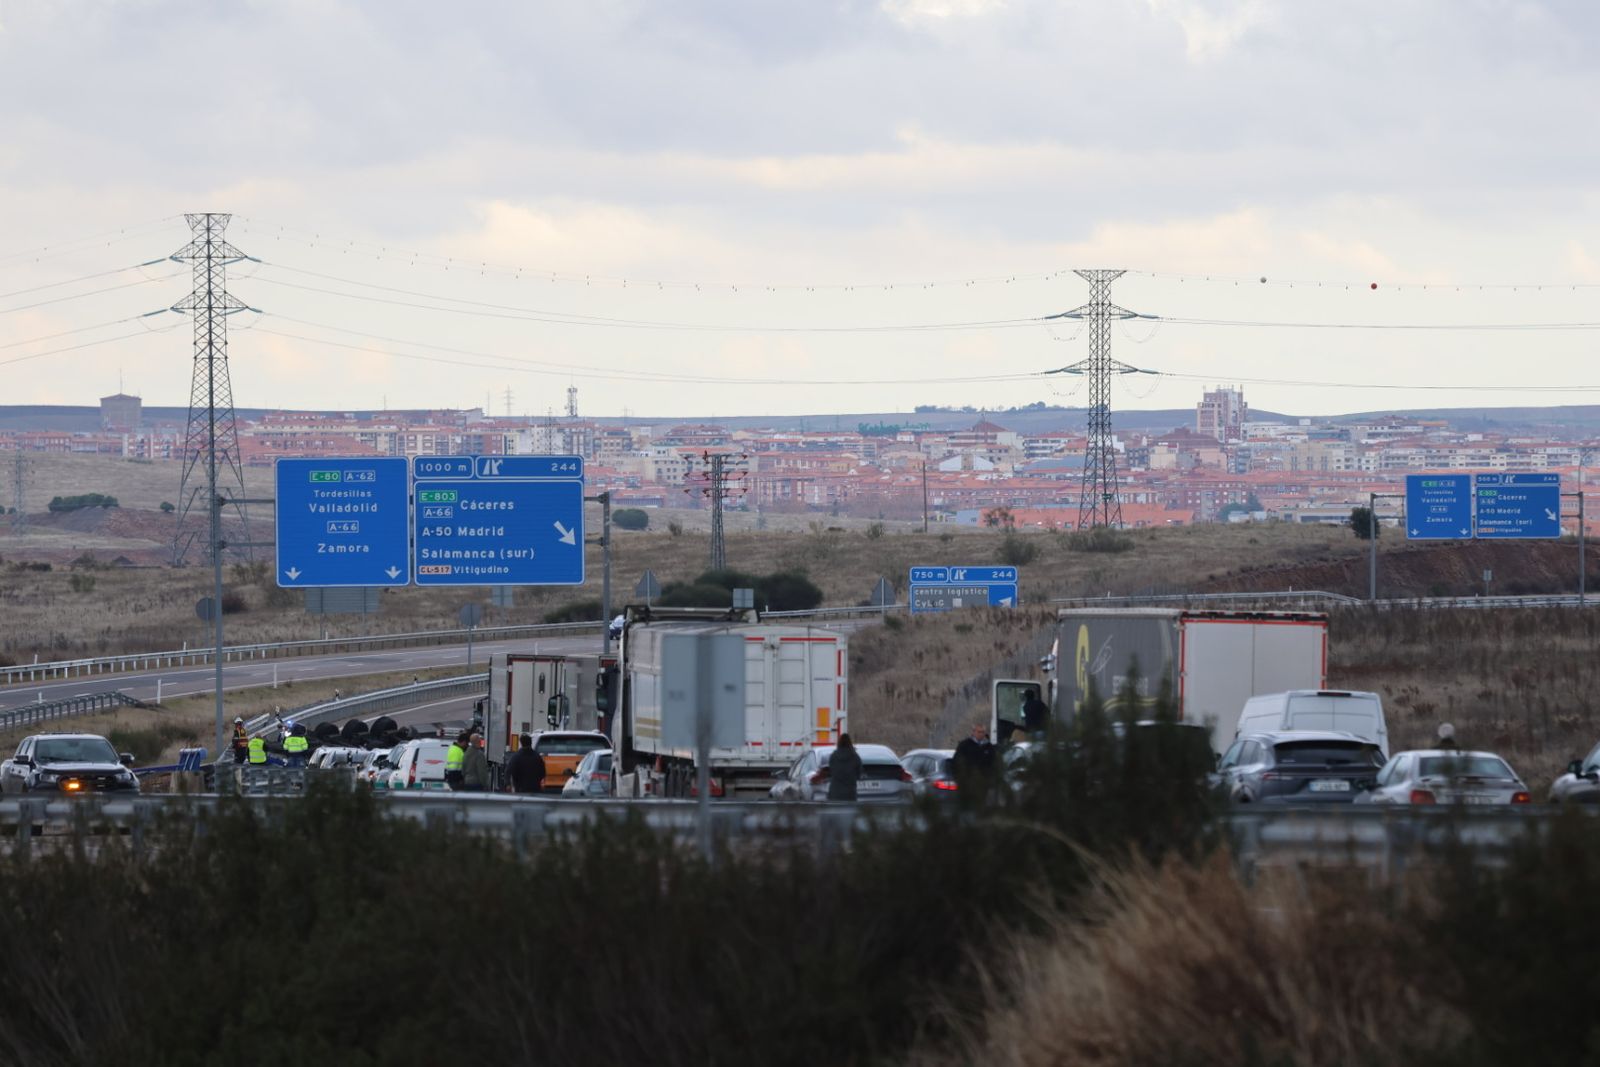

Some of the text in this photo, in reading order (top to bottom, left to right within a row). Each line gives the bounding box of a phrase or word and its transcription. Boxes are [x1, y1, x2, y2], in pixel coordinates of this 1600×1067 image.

[419, 463, 467, 472] 1000 m
[551, 463, 577, 472] 244
[311, 472, 374, 481] E-80 A-62
[313, 489, 372, 498] Tordesillas
[420, 491, 457, 501] E-803
[309, 502, 378, 513] Valladolid
[460, 499, 515, 511] Cáceres
[424, 508, 452, 517] A-66
[329, 522, 357, 532] A-66
[421, 526, 504, 537] A-50 Madrid
[318, 543, 370, 553] Zamora
[421, 548, 535, 560] Salamanca (sur)
[453, 565, 509, 576] Vitigudino
